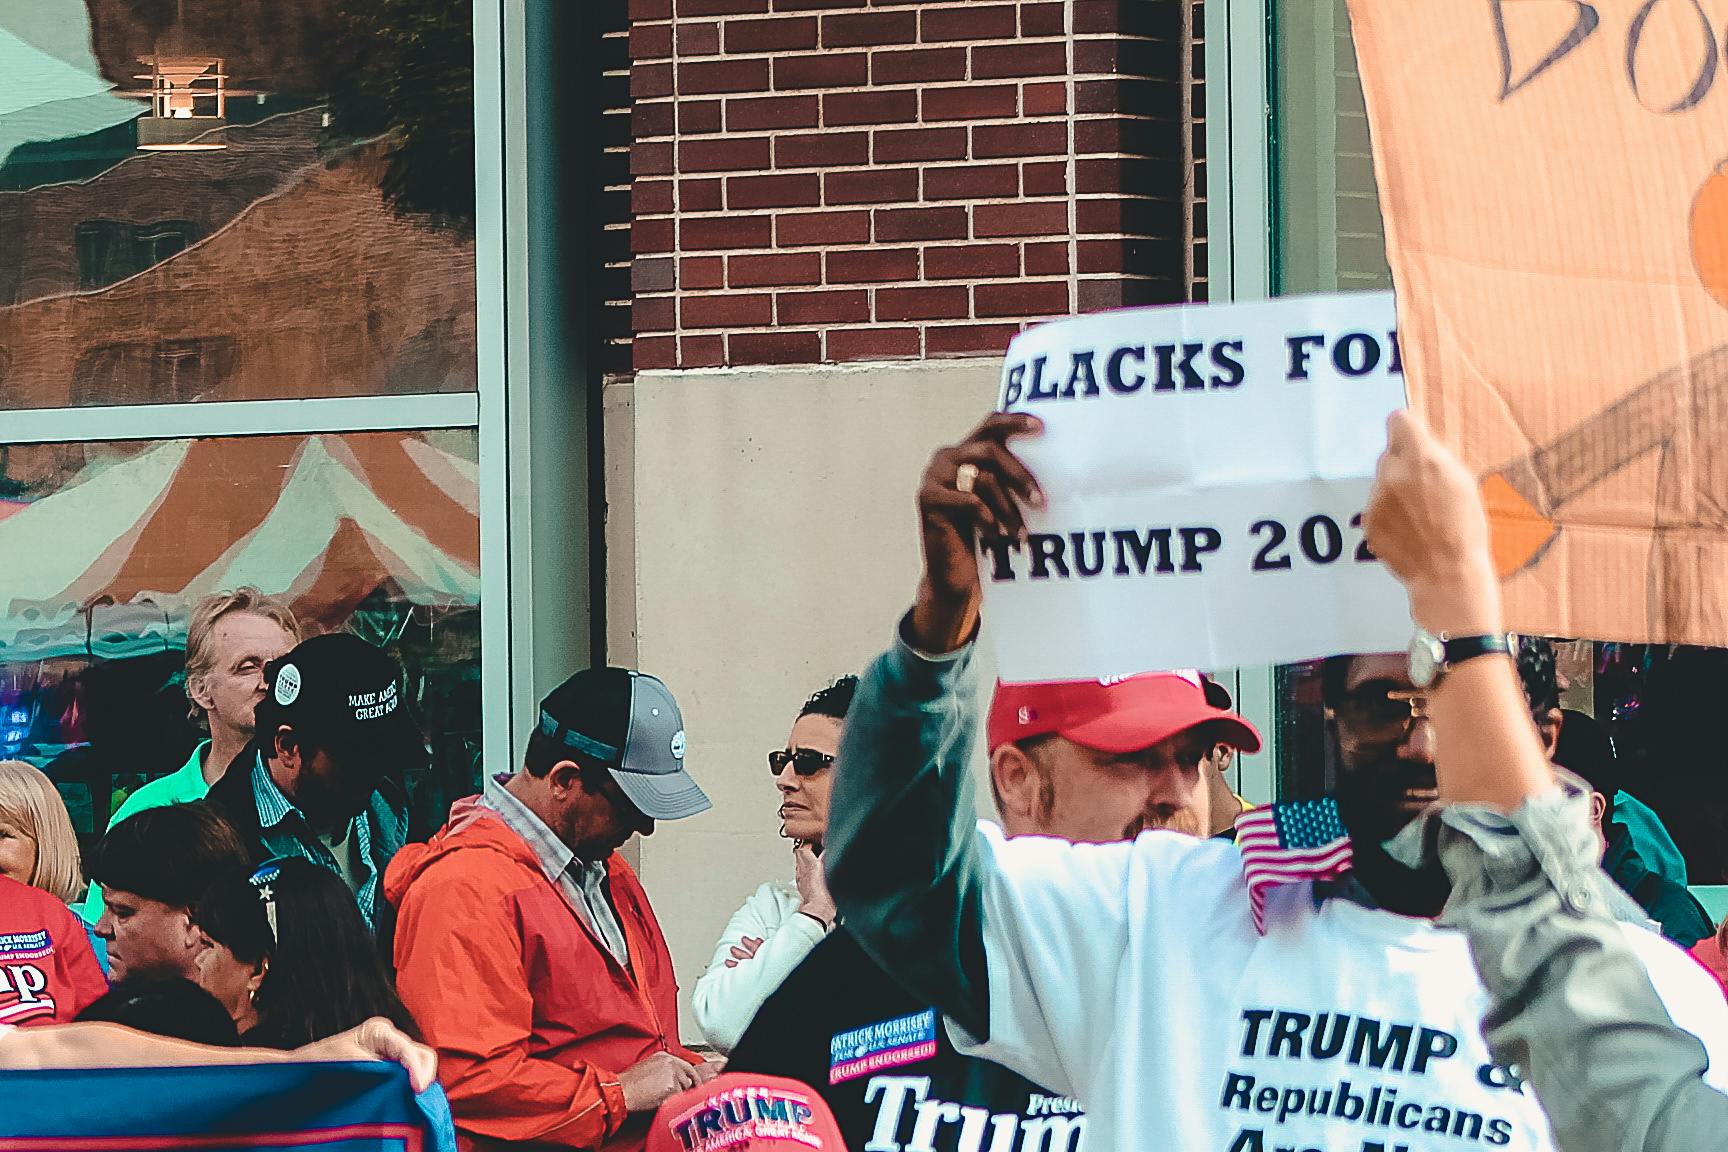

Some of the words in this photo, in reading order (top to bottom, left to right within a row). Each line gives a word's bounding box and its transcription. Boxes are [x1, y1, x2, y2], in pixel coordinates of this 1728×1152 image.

[1003, 340, 1246, 411] BLACKS
[979, 526, 1222, 583] TRUMP
[349, 693, 375, 707] MAKE
[355, 705, 384, 720] GREAT
[1239, 1009, 1458, 1075] TRUMP
[669, 1097, 816, 1152] TRUMP
[1220, 1071, 1513, 1145] Republicans
[705, 1126, 753, 1152] AMERICA
